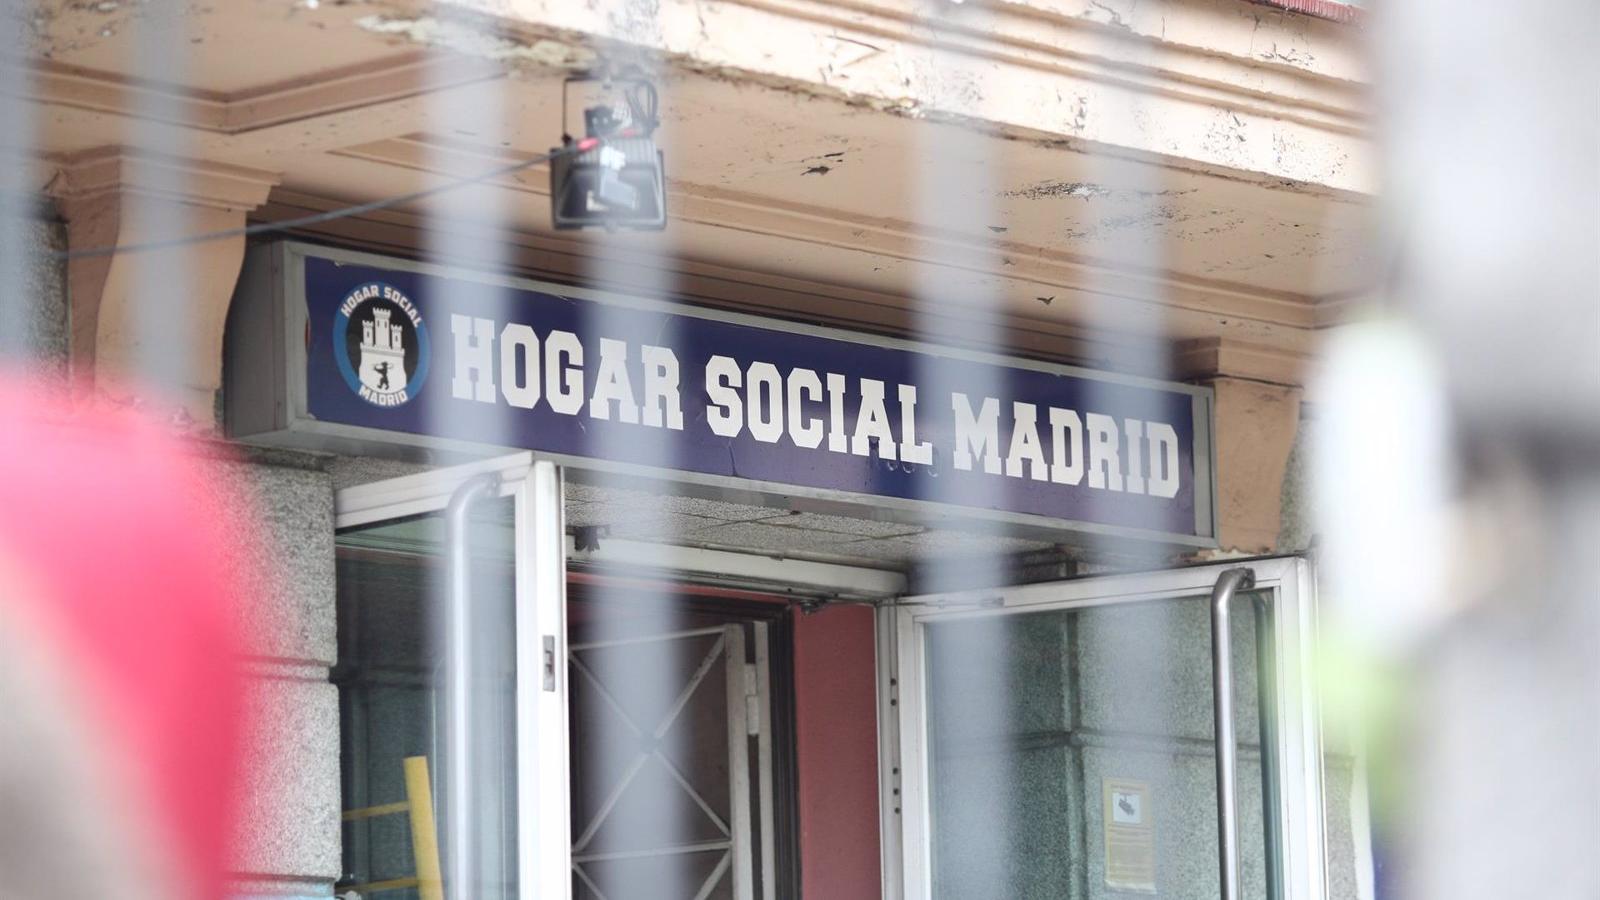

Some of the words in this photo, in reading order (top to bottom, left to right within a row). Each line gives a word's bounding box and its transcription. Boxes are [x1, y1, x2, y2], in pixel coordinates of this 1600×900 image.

[341, 285, 379, 318] HOGAR
[383, 286, 422, 328] SOCIAL
[359, 383, 409, 406] MADRID
[451, 313, 684, 430] HOGAR
[705, 355, 933, 466] SOCIAL
[951, 392, 1180, 499] MADRID
